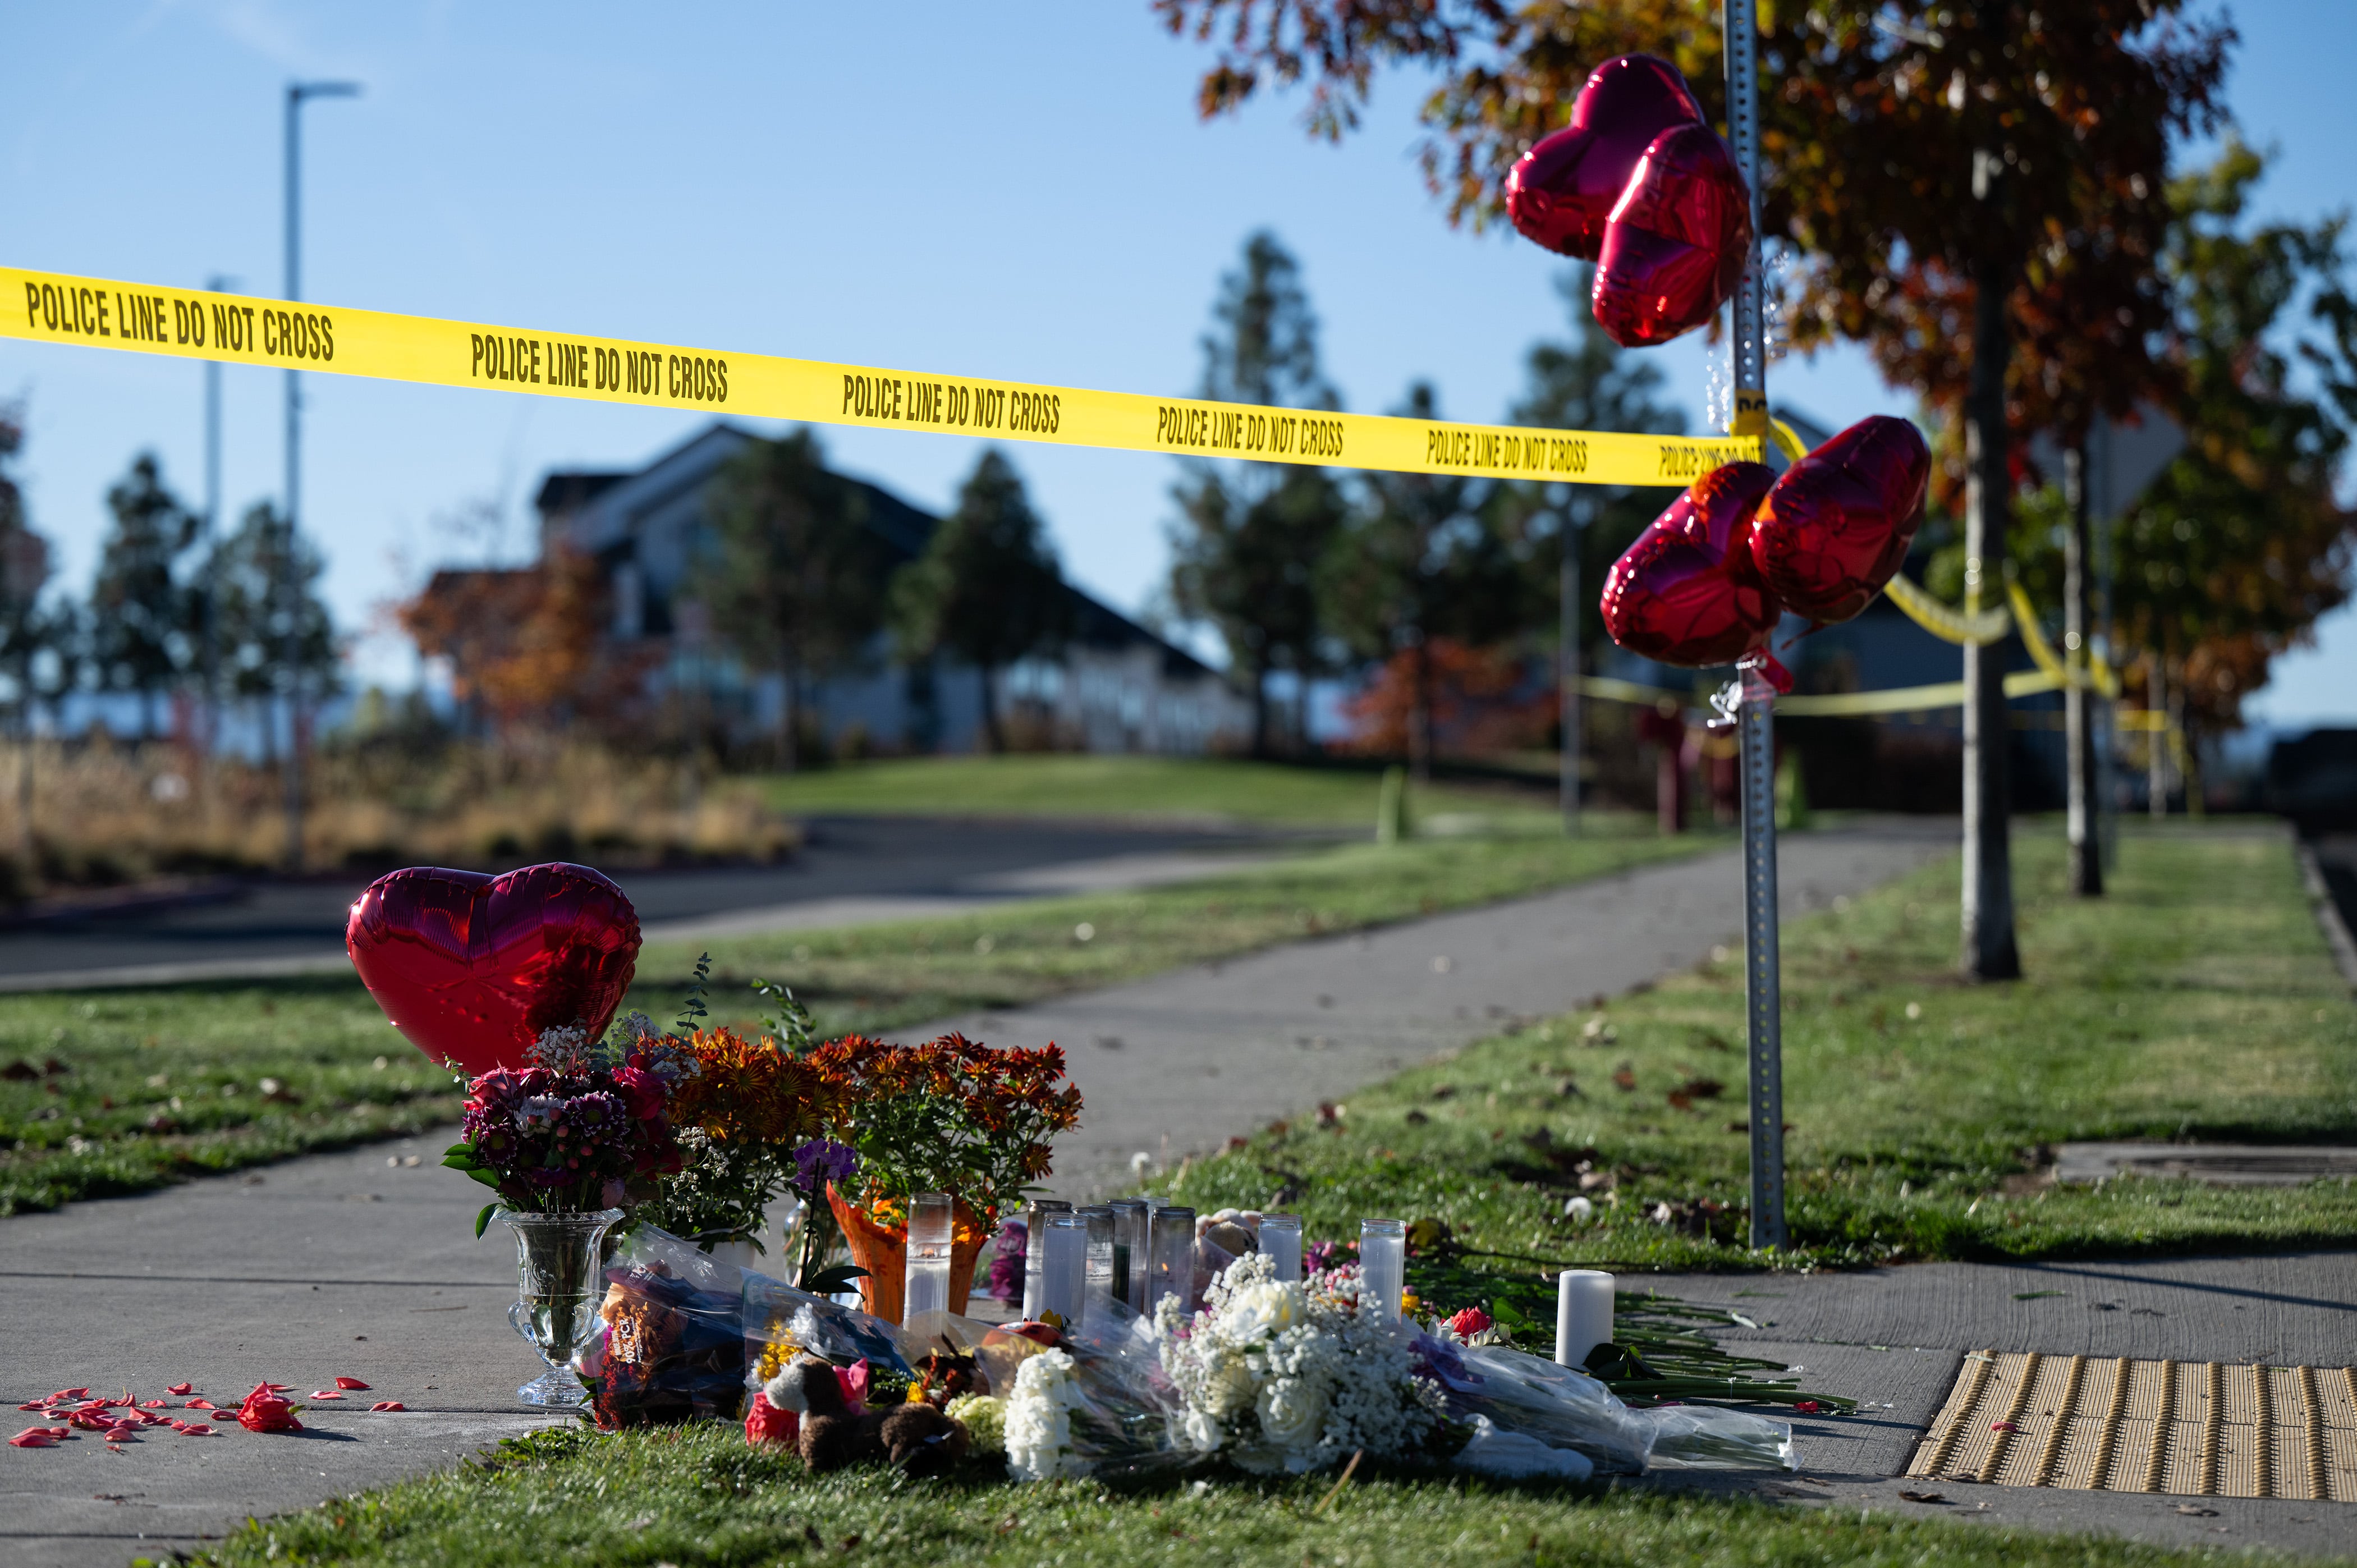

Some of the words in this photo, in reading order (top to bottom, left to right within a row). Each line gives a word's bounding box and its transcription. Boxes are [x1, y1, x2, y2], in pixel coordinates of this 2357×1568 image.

[25, 282, 110, 337] POLICE
[116, 292, 168, 343] LINE
[173, 299, 205, 347] DO
[212, 304, 255, 352] NOT
[263, 309, 334, 361] CROSS
[471, 333, 540, 384] POLICE
[547, 342, 588, 388] LINE
[594, 347, 620, 392] DO
[626, 350, 663, 396] NOT
[669, 354, 728, 403] CROSS
[842, 374, 902, 420] POLICE
[906, 381, 942, 423] LINE
[947, 385, 969, 426] DO
[973, 388, 1006, 429] NOT
[1010, 391, 1060, 434] CROSS
[1157, 406, 1208, 447] POLICE
[1212, 411, 1242, 450] LINE
[1245, 414, 1266, 452] DO
[1269, 416, 1296, 453] NOT
[1300, 418, 1343, 457] CROSS
[1427, 429, 1470, 466] POLICE
[1474, 434, 1500, 467] LINE
[1503, 435, 1520, 469] DO
[1524, 437, 1547, 470] NOT
[1550, 438, 1587, 473] CROSS
[1659, 446, 1697, 477] POLICE
[619, 1318, 631, 1339] PCR
[623, 1341, 636, 1364] 90%
